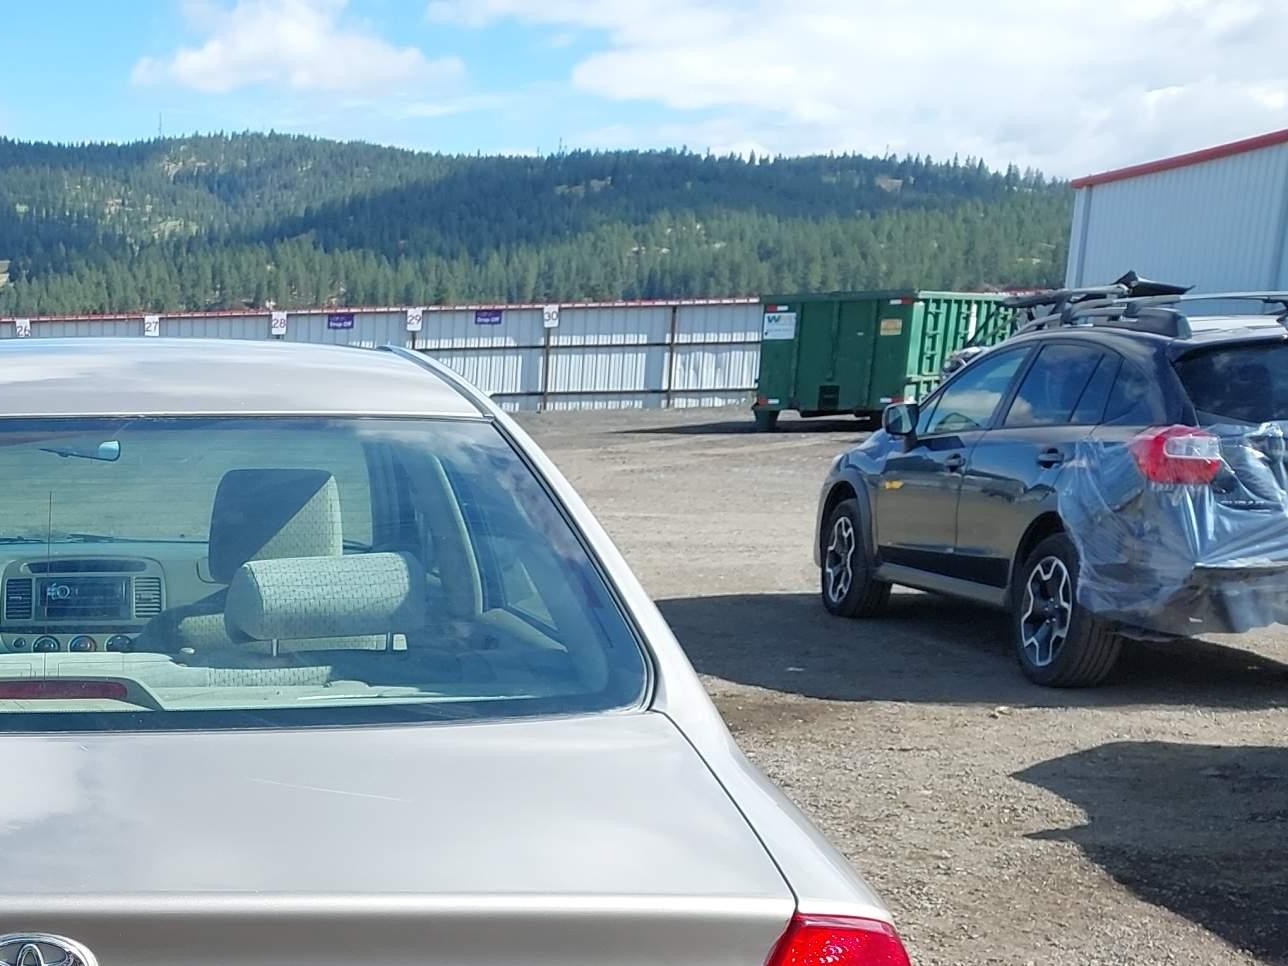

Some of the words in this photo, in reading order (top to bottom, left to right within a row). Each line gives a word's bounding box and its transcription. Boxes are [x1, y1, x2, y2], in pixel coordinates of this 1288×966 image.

[407, 314, 422, 325] 29
[545, 311, 558, 321] 30
[144, 321, 159, 332] 27
[272, 318, 286, 329] 28
[16, 325, 31, 337] 26
